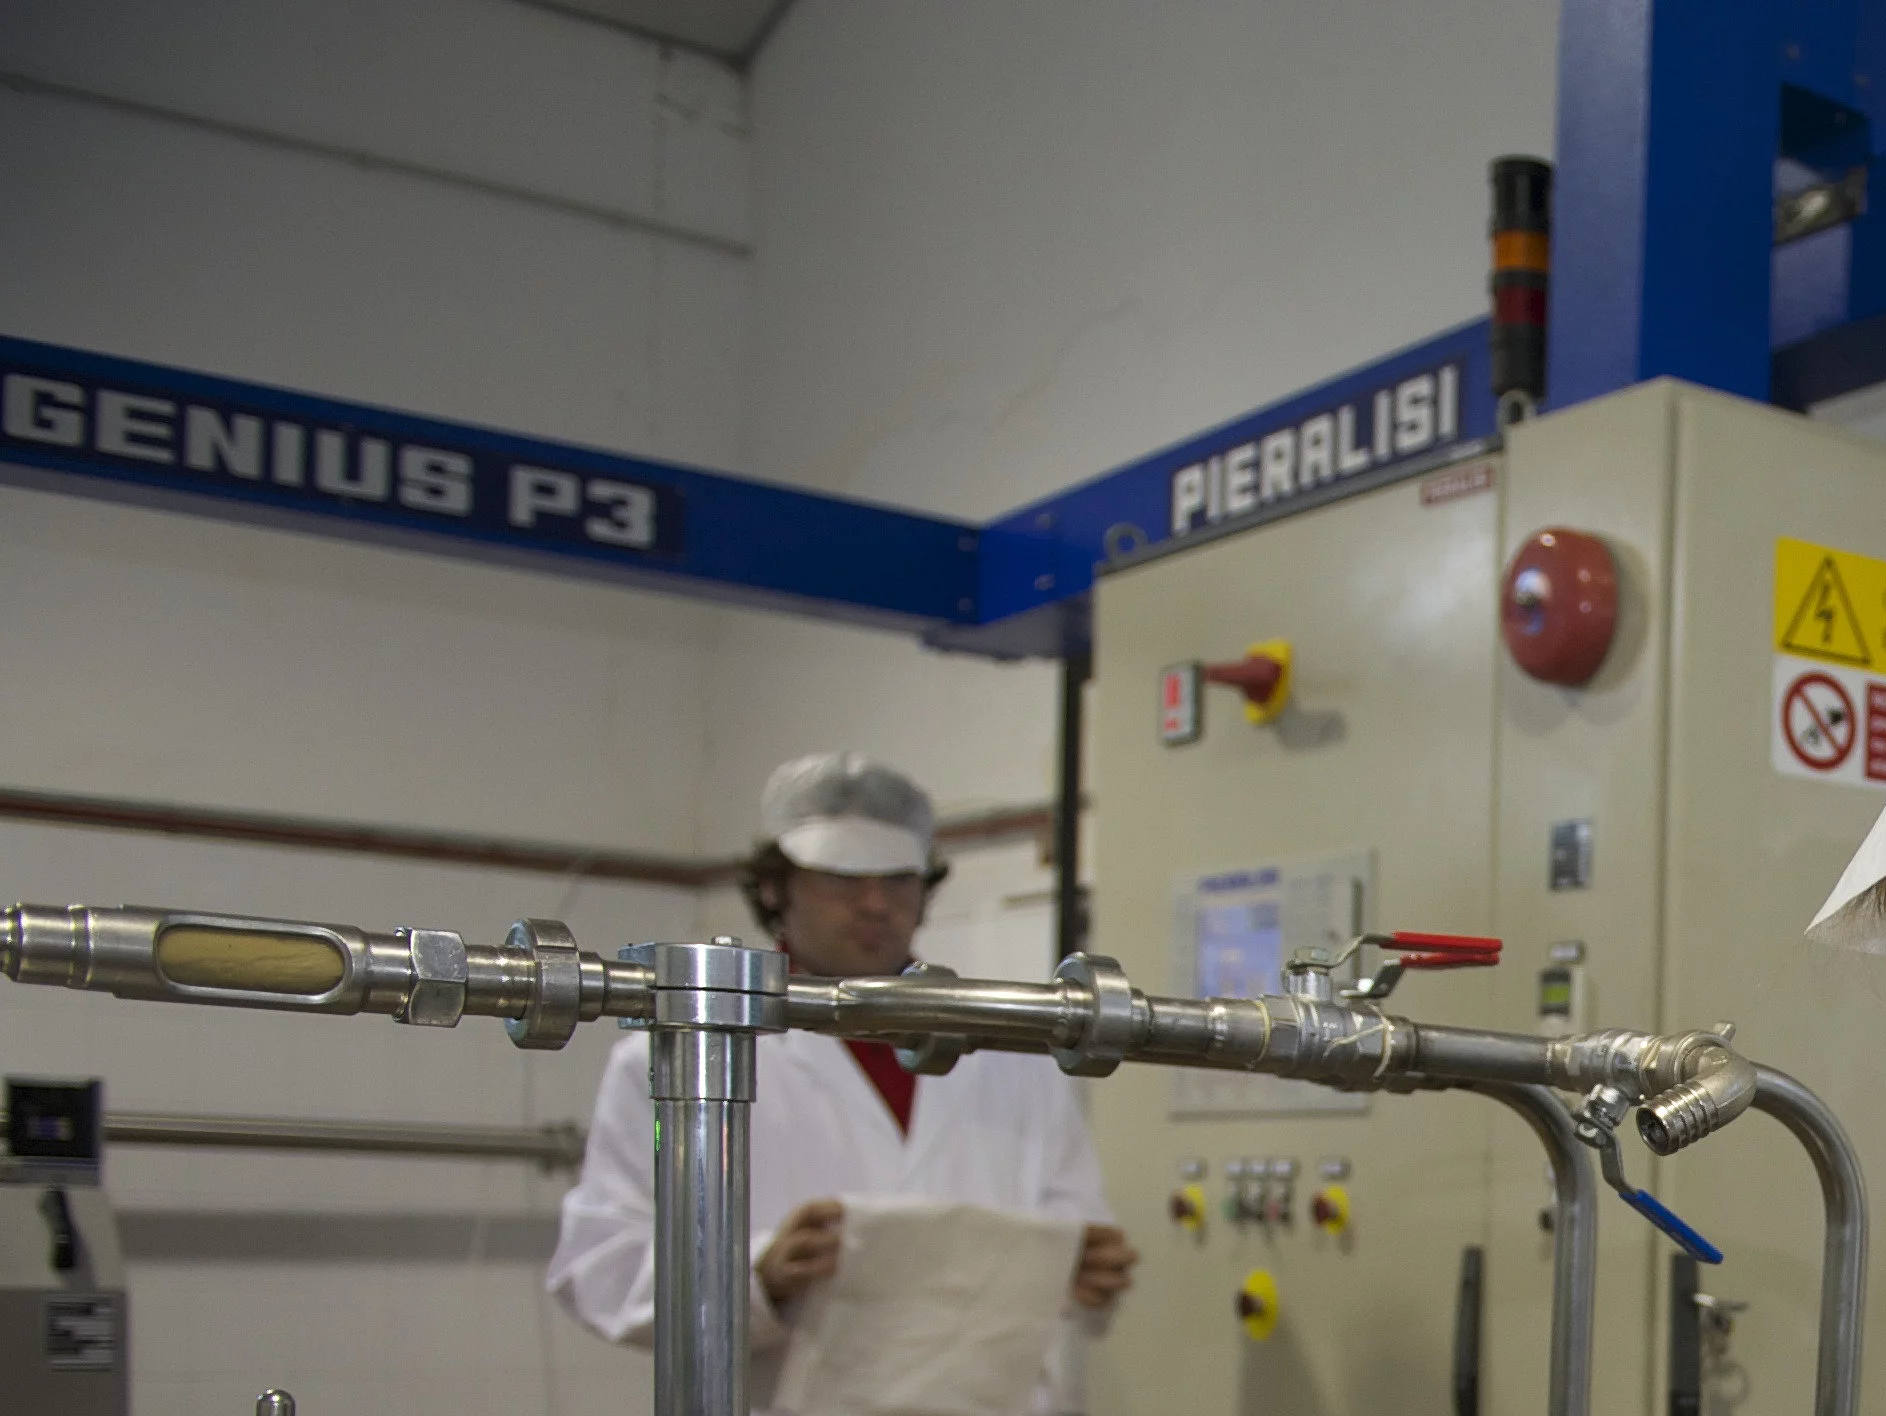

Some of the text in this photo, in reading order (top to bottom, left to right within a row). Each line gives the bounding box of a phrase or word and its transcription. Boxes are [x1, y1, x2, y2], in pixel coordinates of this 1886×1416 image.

[4, 373, 656, 549] GENIUS P3
[1172, 366, 1459, 533] PIERALISI
